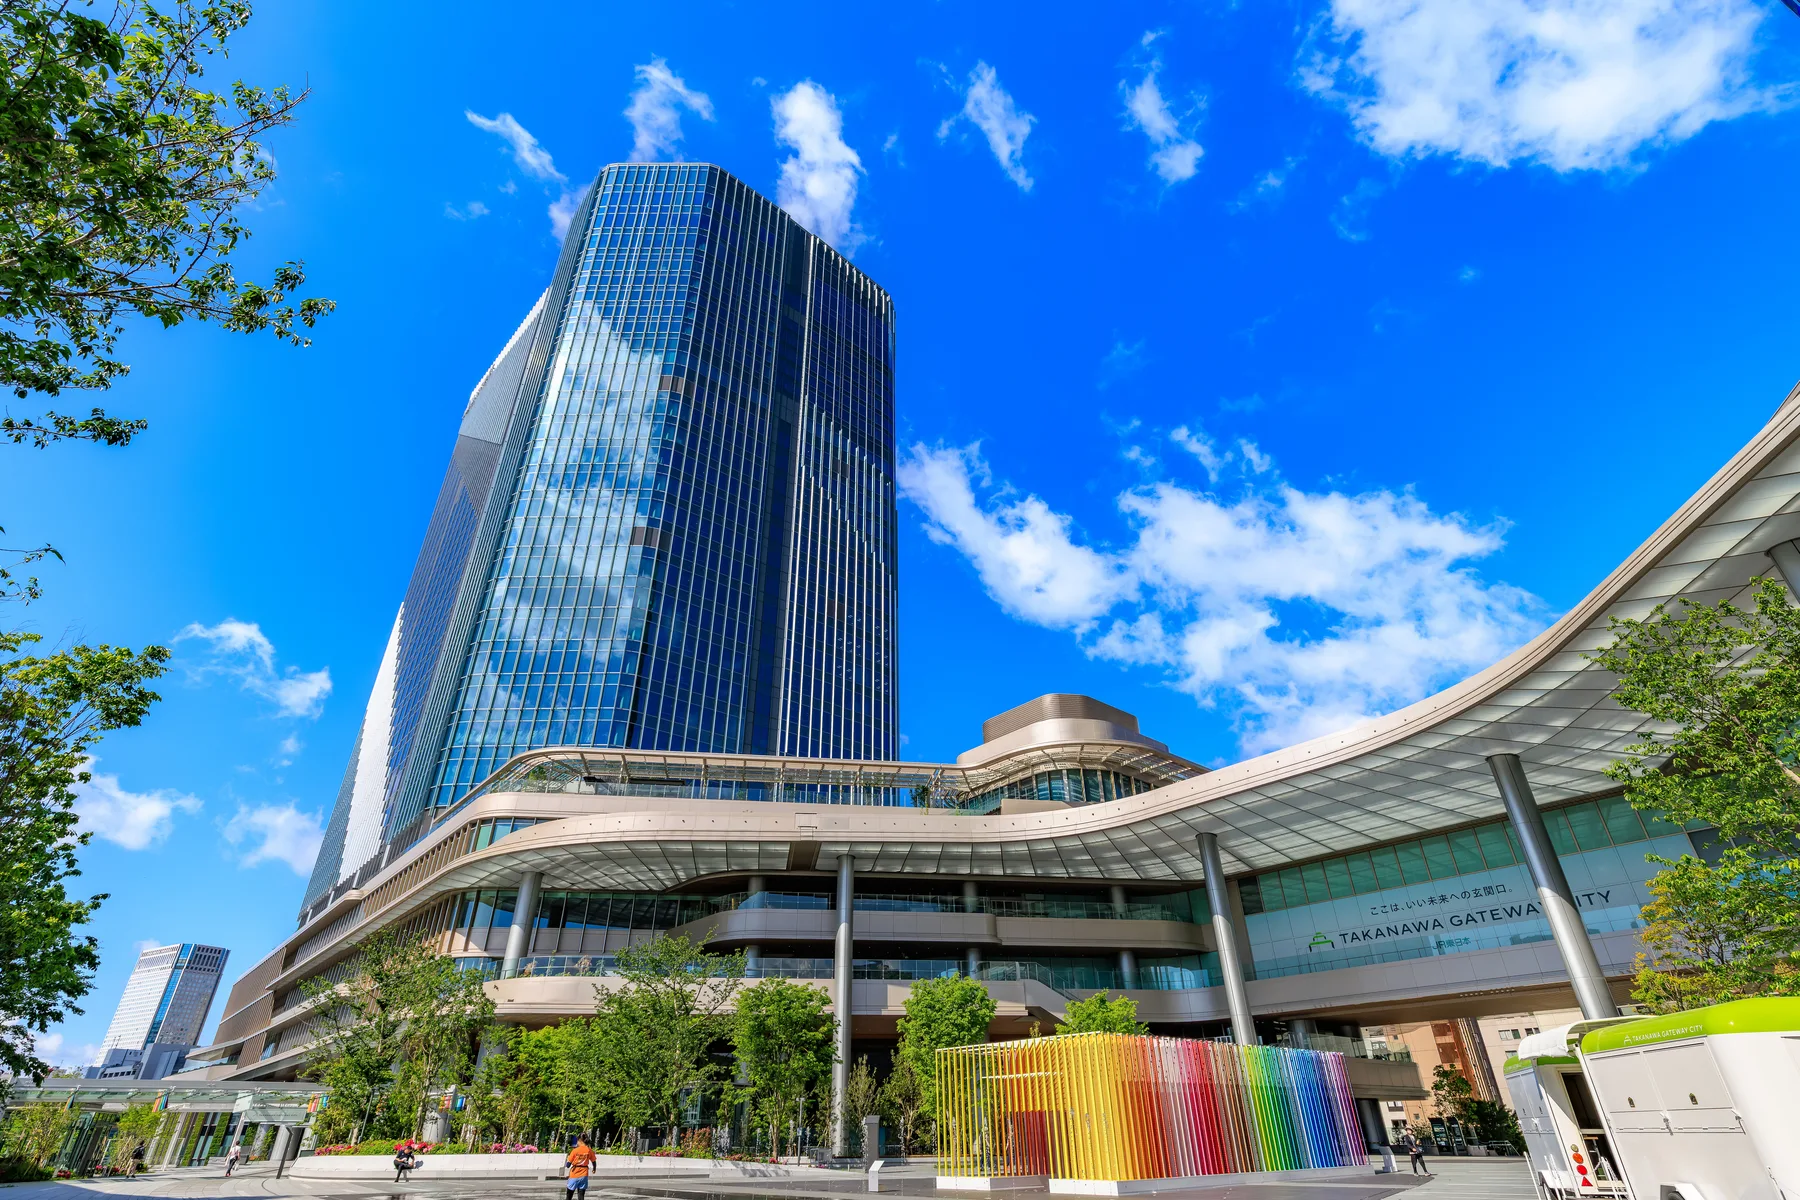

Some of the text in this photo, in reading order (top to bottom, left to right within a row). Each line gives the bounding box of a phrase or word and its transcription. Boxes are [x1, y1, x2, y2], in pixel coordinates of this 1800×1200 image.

[1370, 884, 1513, 916] ここは、いい未来への玄関口。
[1339, 890, 1611, 944] TAKANAWA GATEWA ITY
[1432, 936, 1472, 950] JR東日本
[1632, 1024, 1703, 1042] TAKANAWA GATEWAY CITY
